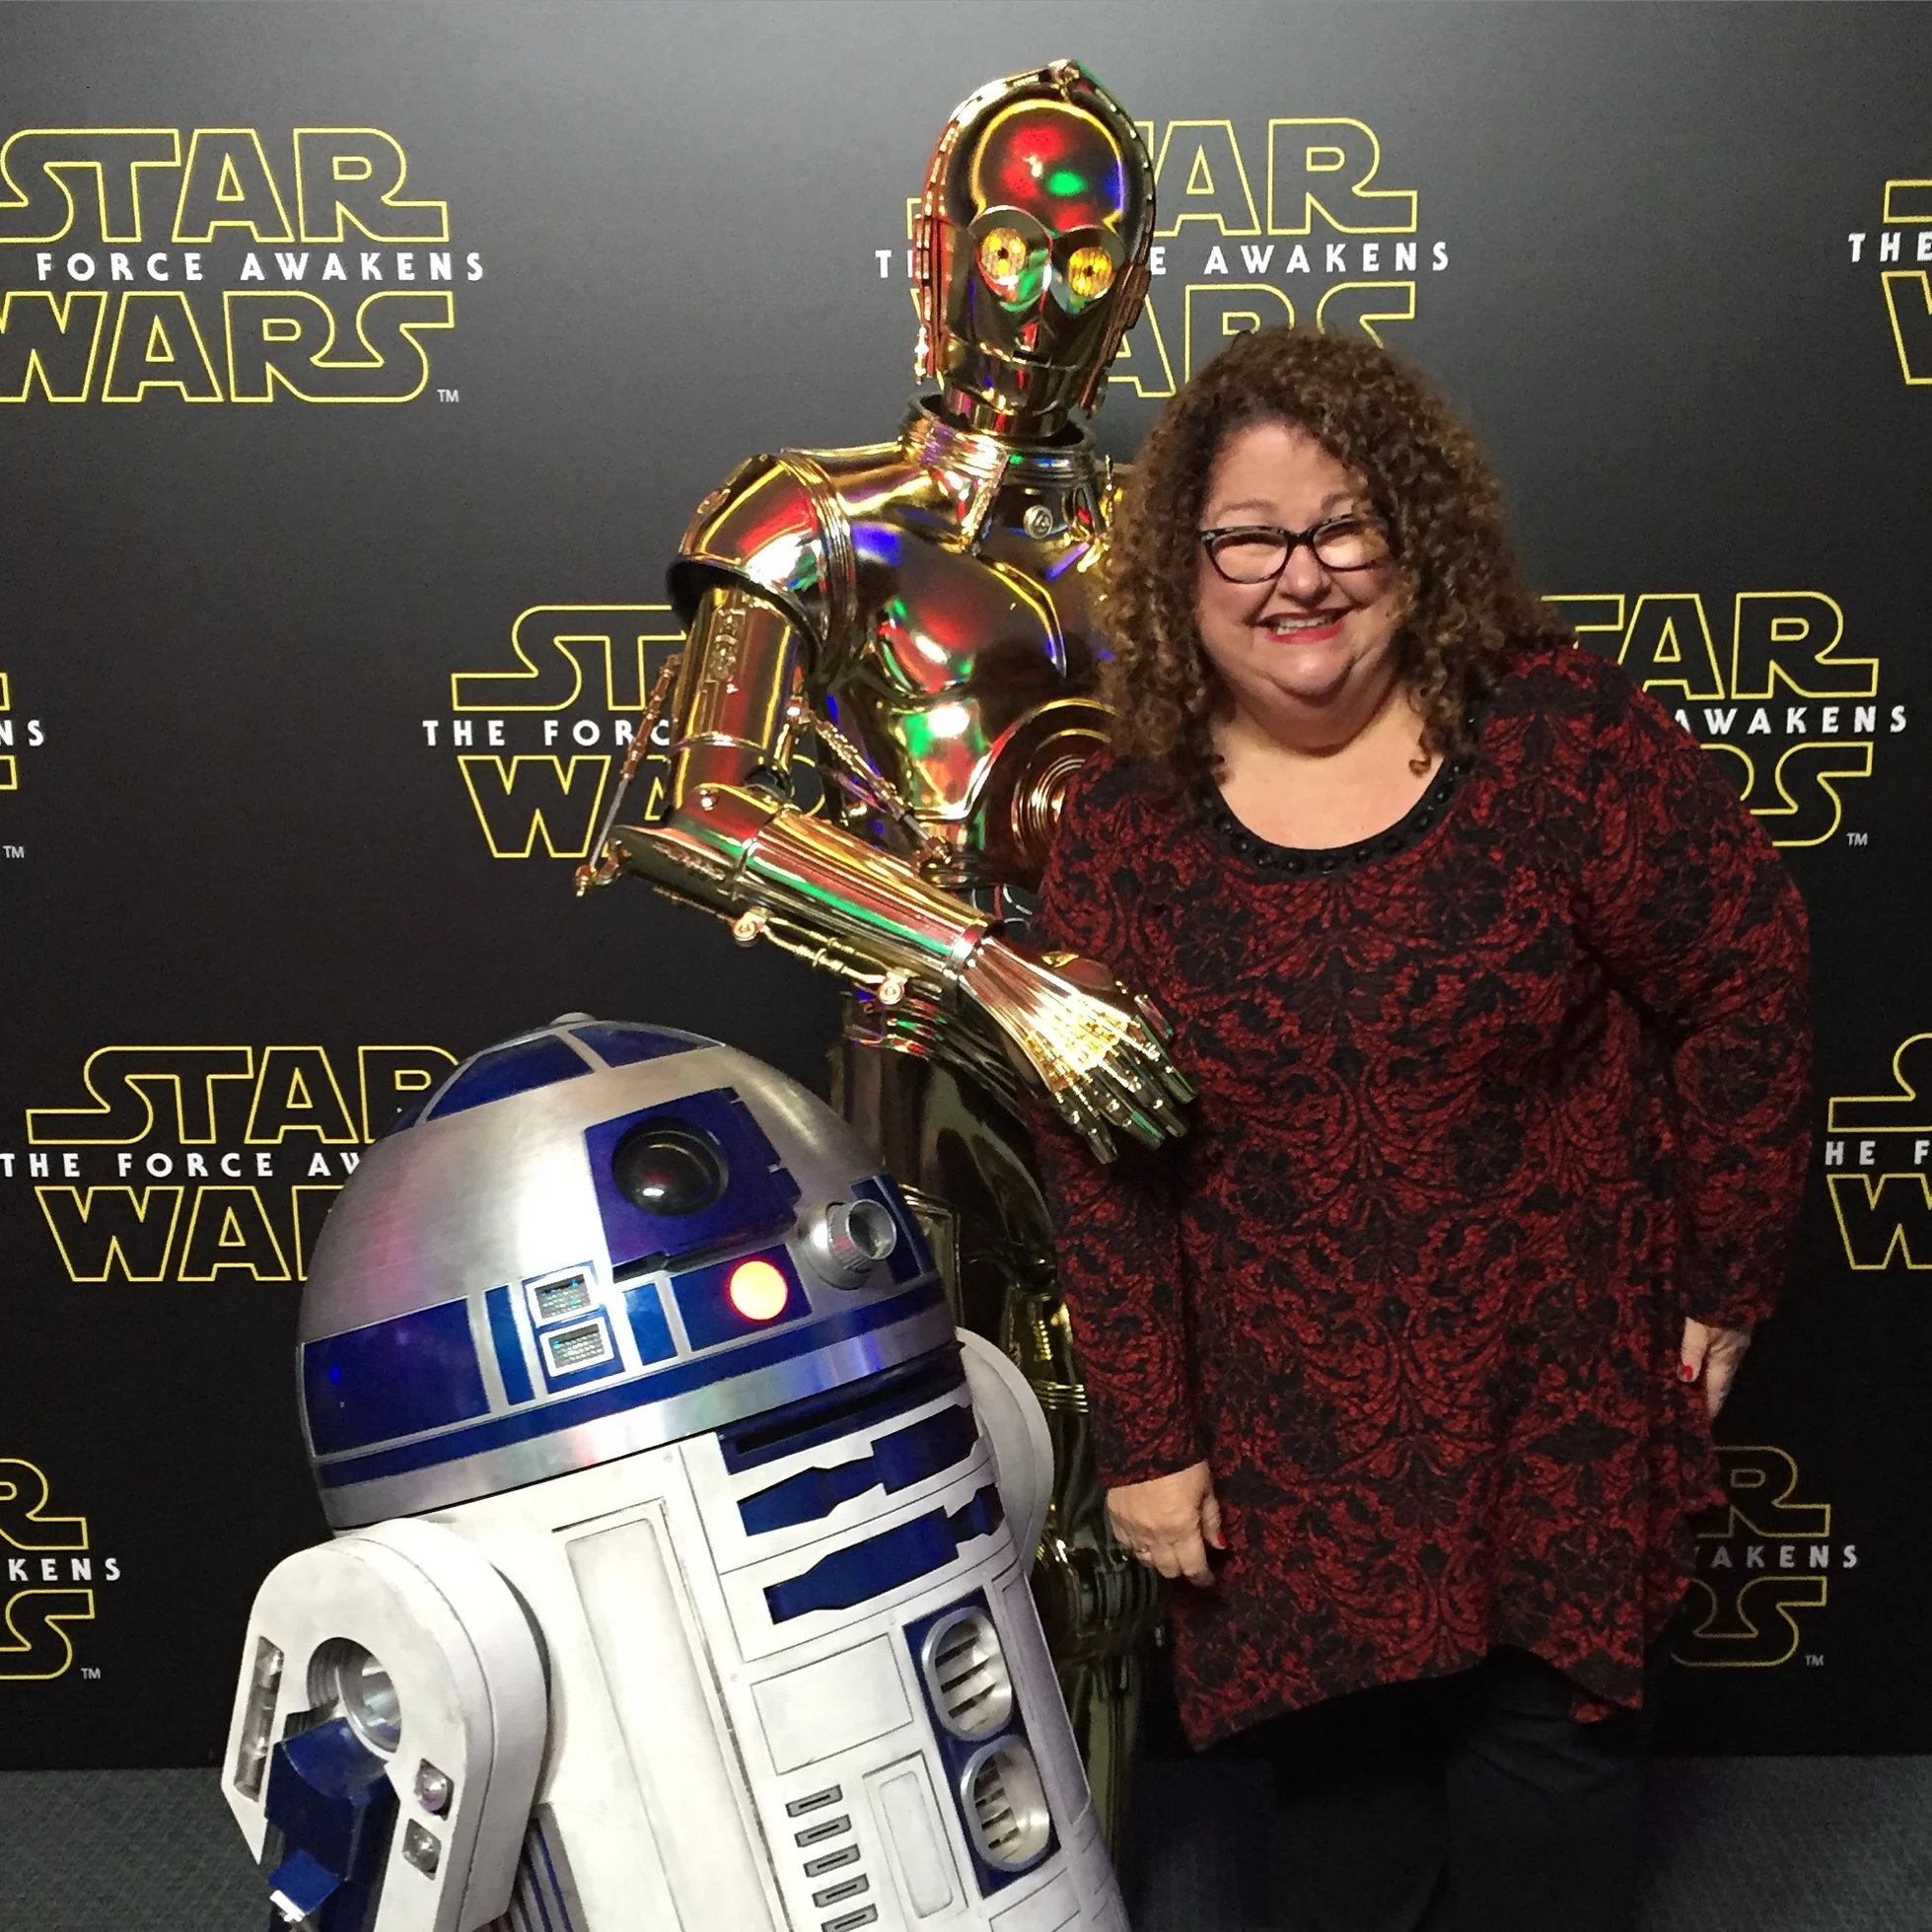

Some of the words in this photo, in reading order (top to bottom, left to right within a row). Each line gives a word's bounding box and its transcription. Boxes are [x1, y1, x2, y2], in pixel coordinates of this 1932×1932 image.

[0, 128, 449, 243] STAR
[36, 252, 203, 281] FORCE
[240, 252, 484, 281] AWAKENS
[1203, 242, 1450, 276] AWAKENS
[0, 291, 455, 402] WARS
[422, 720, 506, 747] THE
[544, 720, 671, 747] FORC
[0, 1153, 81, 1178] THE
[118, 1153, 274, 1178] FORCE
[1825, 1140, 1876, 1166] HE
